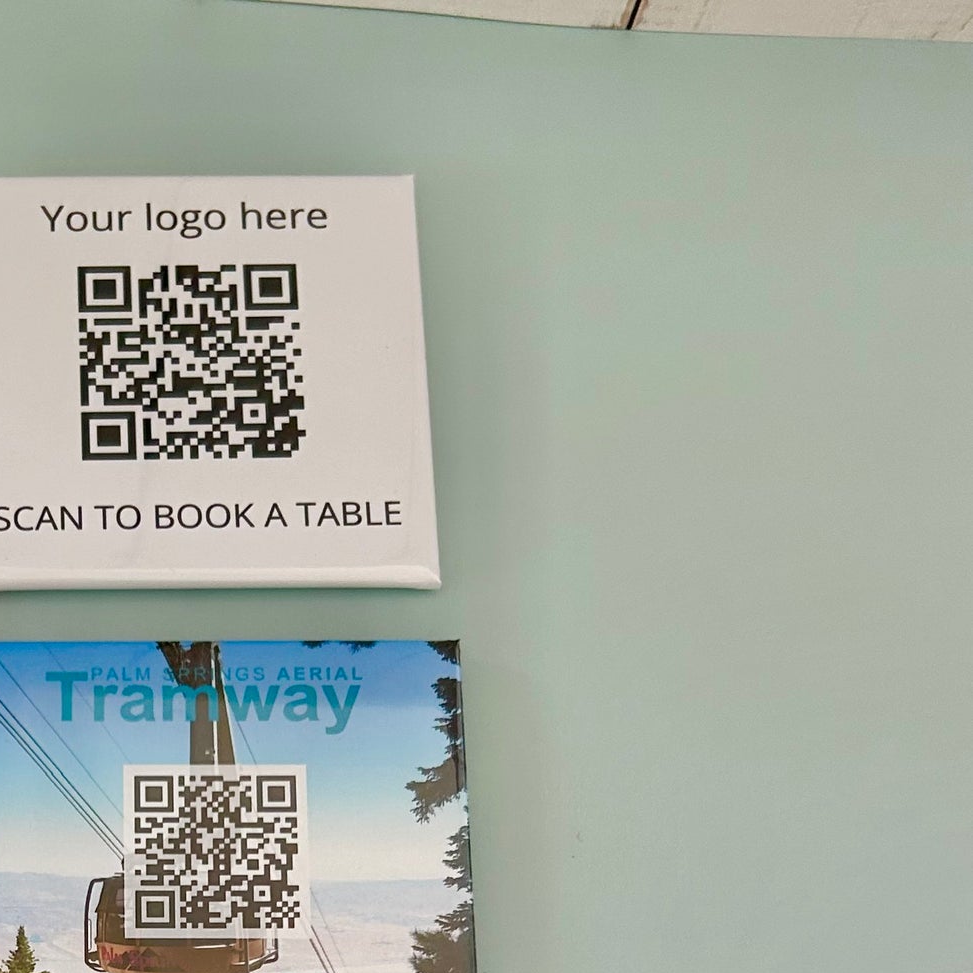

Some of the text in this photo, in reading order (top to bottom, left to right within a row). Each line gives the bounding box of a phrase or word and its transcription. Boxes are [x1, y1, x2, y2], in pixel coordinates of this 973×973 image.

[41, 202, 327, 239] Your logo here
[94, 505, 141, 529] TO
[155, 504, 254, 529] BOOK
[265, 503, 287, 527] A
[296, 501, 401, 526] TABLE
[90, 666, 151, 681] PALM
[277, 666, 363, 681] AERIAL
[45, 671, 361, 735] Tramway
